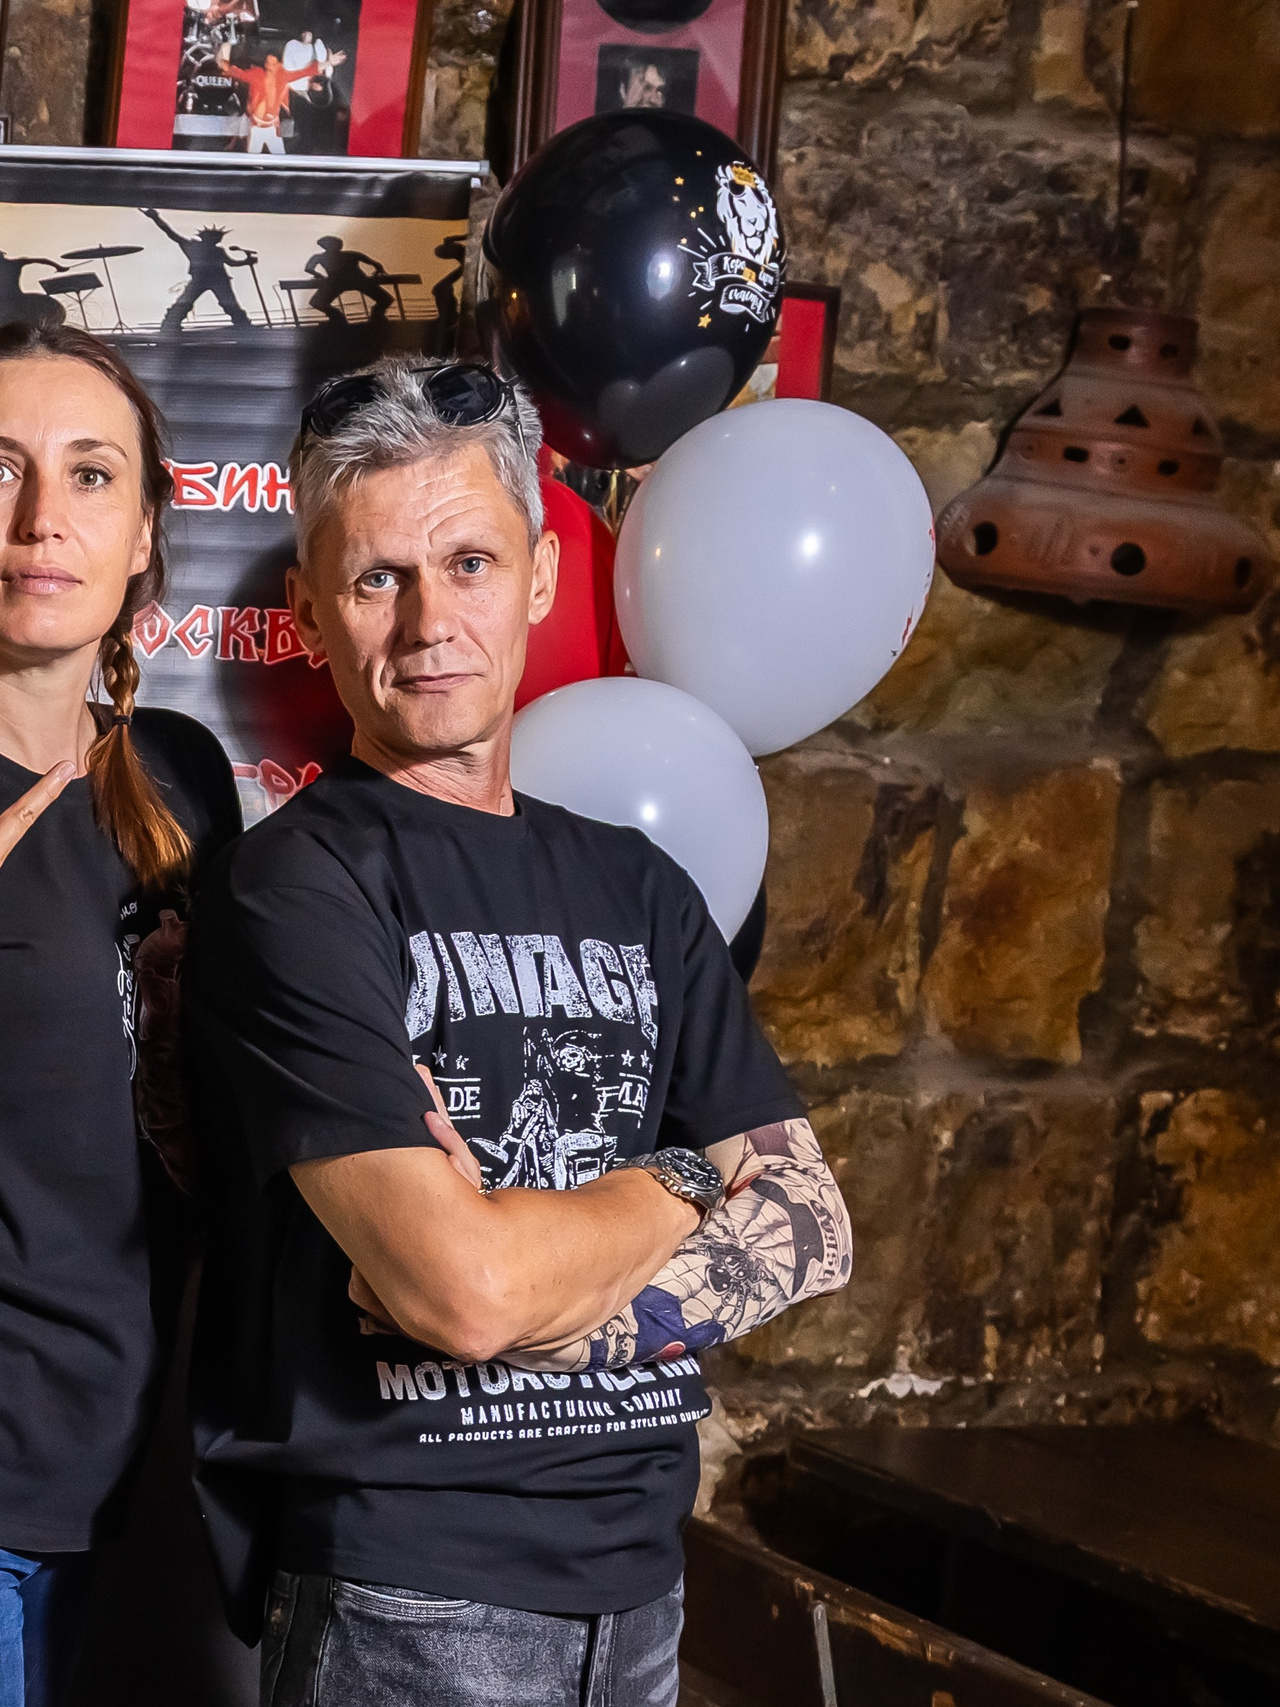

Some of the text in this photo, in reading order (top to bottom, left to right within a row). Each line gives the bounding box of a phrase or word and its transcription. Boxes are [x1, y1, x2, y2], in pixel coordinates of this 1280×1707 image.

[195, 75, 232, 87] QUEEN
[161, 458, 295, 514] БИН
[130, 600, 329, 669] ОСКВ
[447, 1086, 481, 1111] DE
[460, 1388, 682, 1426] MANUFACTURING COMPANY
[419, 1433, 442, 1443] ALL
[448, 1429, 513, 1442] PRODUCTS
[519, 1427, 542, 1439] ARE
[548, 1423, 601, 1437] CRAFTED
[606, 1422, 626, 1433] FOR
[631, 1417, 658, 1430] STYLE
[660, 1414, 678, 1426] AND
